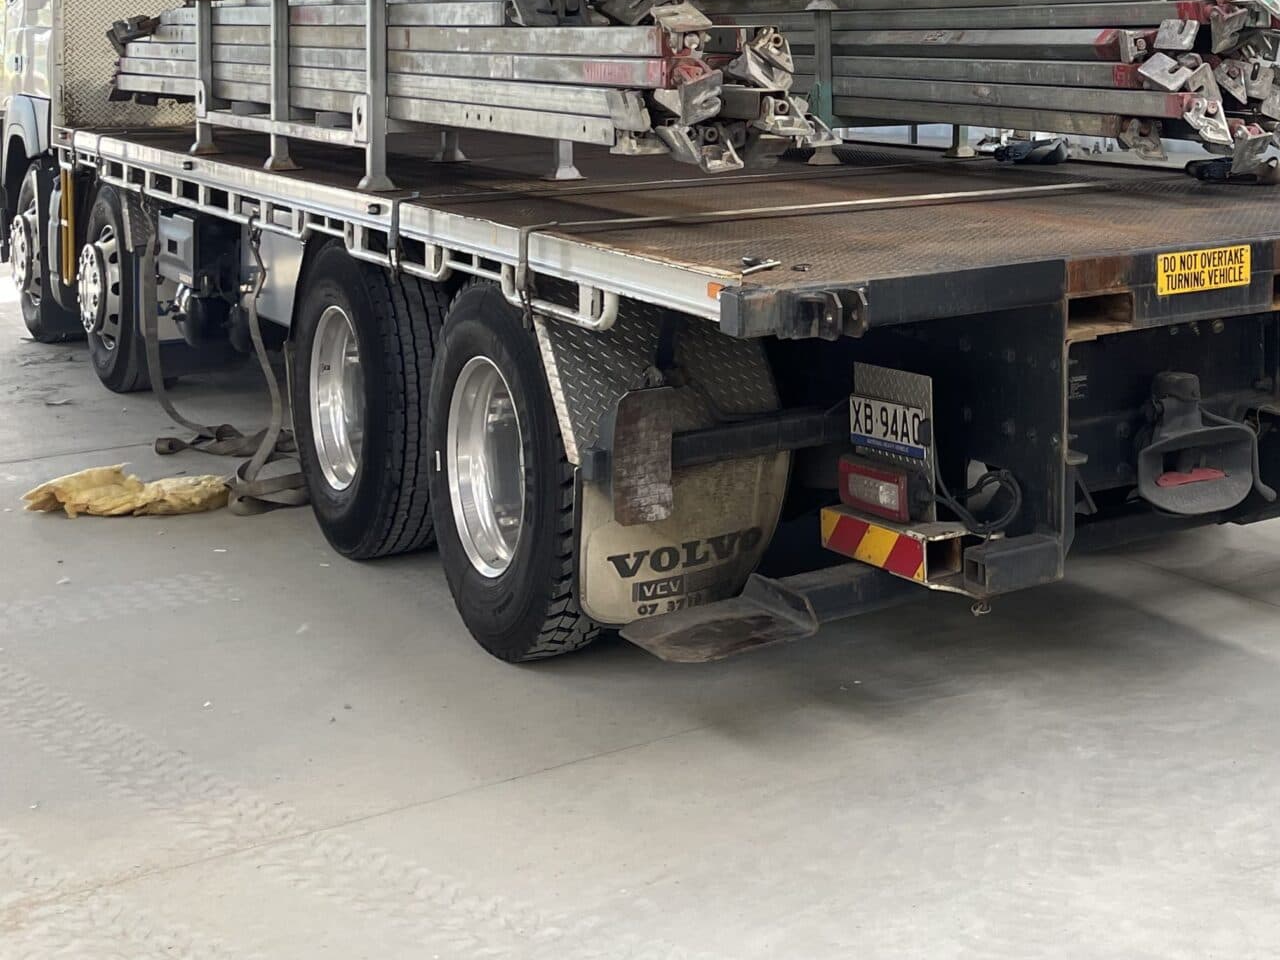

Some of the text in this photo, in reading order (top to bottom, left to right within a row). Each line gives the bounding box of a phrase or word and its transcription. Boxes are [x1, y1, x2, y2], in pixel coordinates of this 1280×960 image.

[1163, 247, 1245, 272] DO NOT OVERTAKE
[1165, 265, 1244, 291] TURNING VEHICLE
[607, 526, 763, 578] VOLVO
[643, 579, 681, 597] VCV
